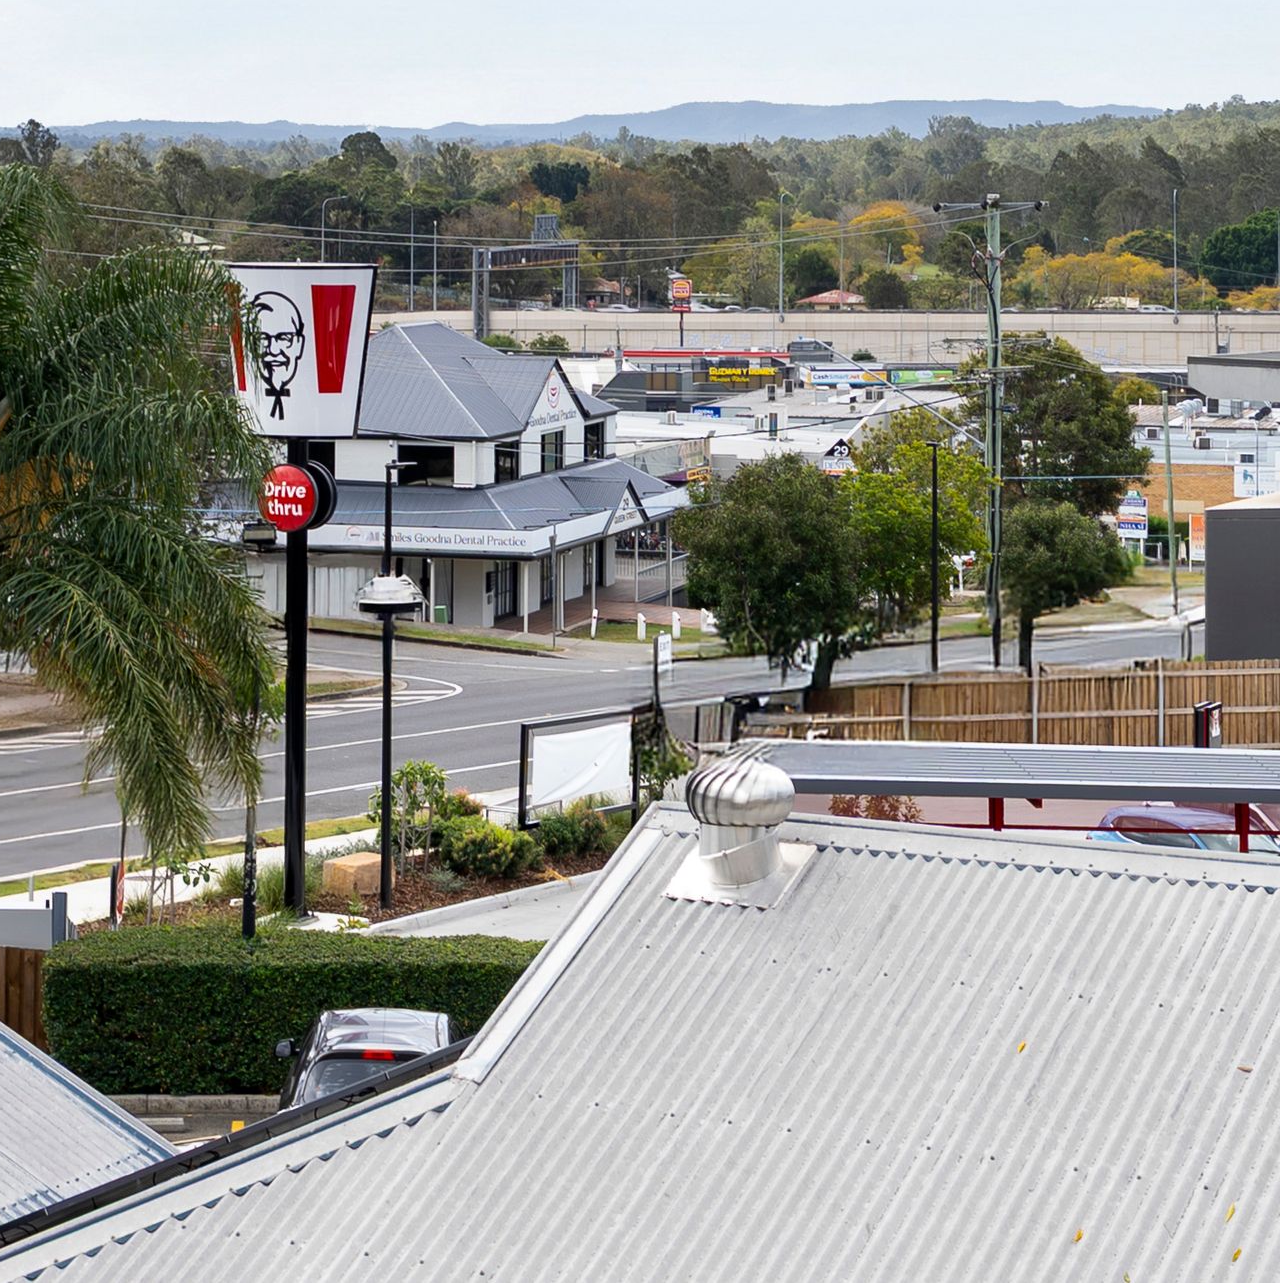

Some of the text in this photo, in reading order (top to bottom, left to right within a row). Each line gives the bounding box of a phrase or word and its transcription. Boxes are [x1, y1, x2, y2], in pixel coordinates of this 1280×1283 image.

[833, 445, 849, 457] 29
[264, 481, 307, 498] Drive
[268, 499, 303, 516] thru
[414, 532, 452, 544] Goodna
[454, 534, 485, 545] Dental
[487, 535, 526, 547] Practice
